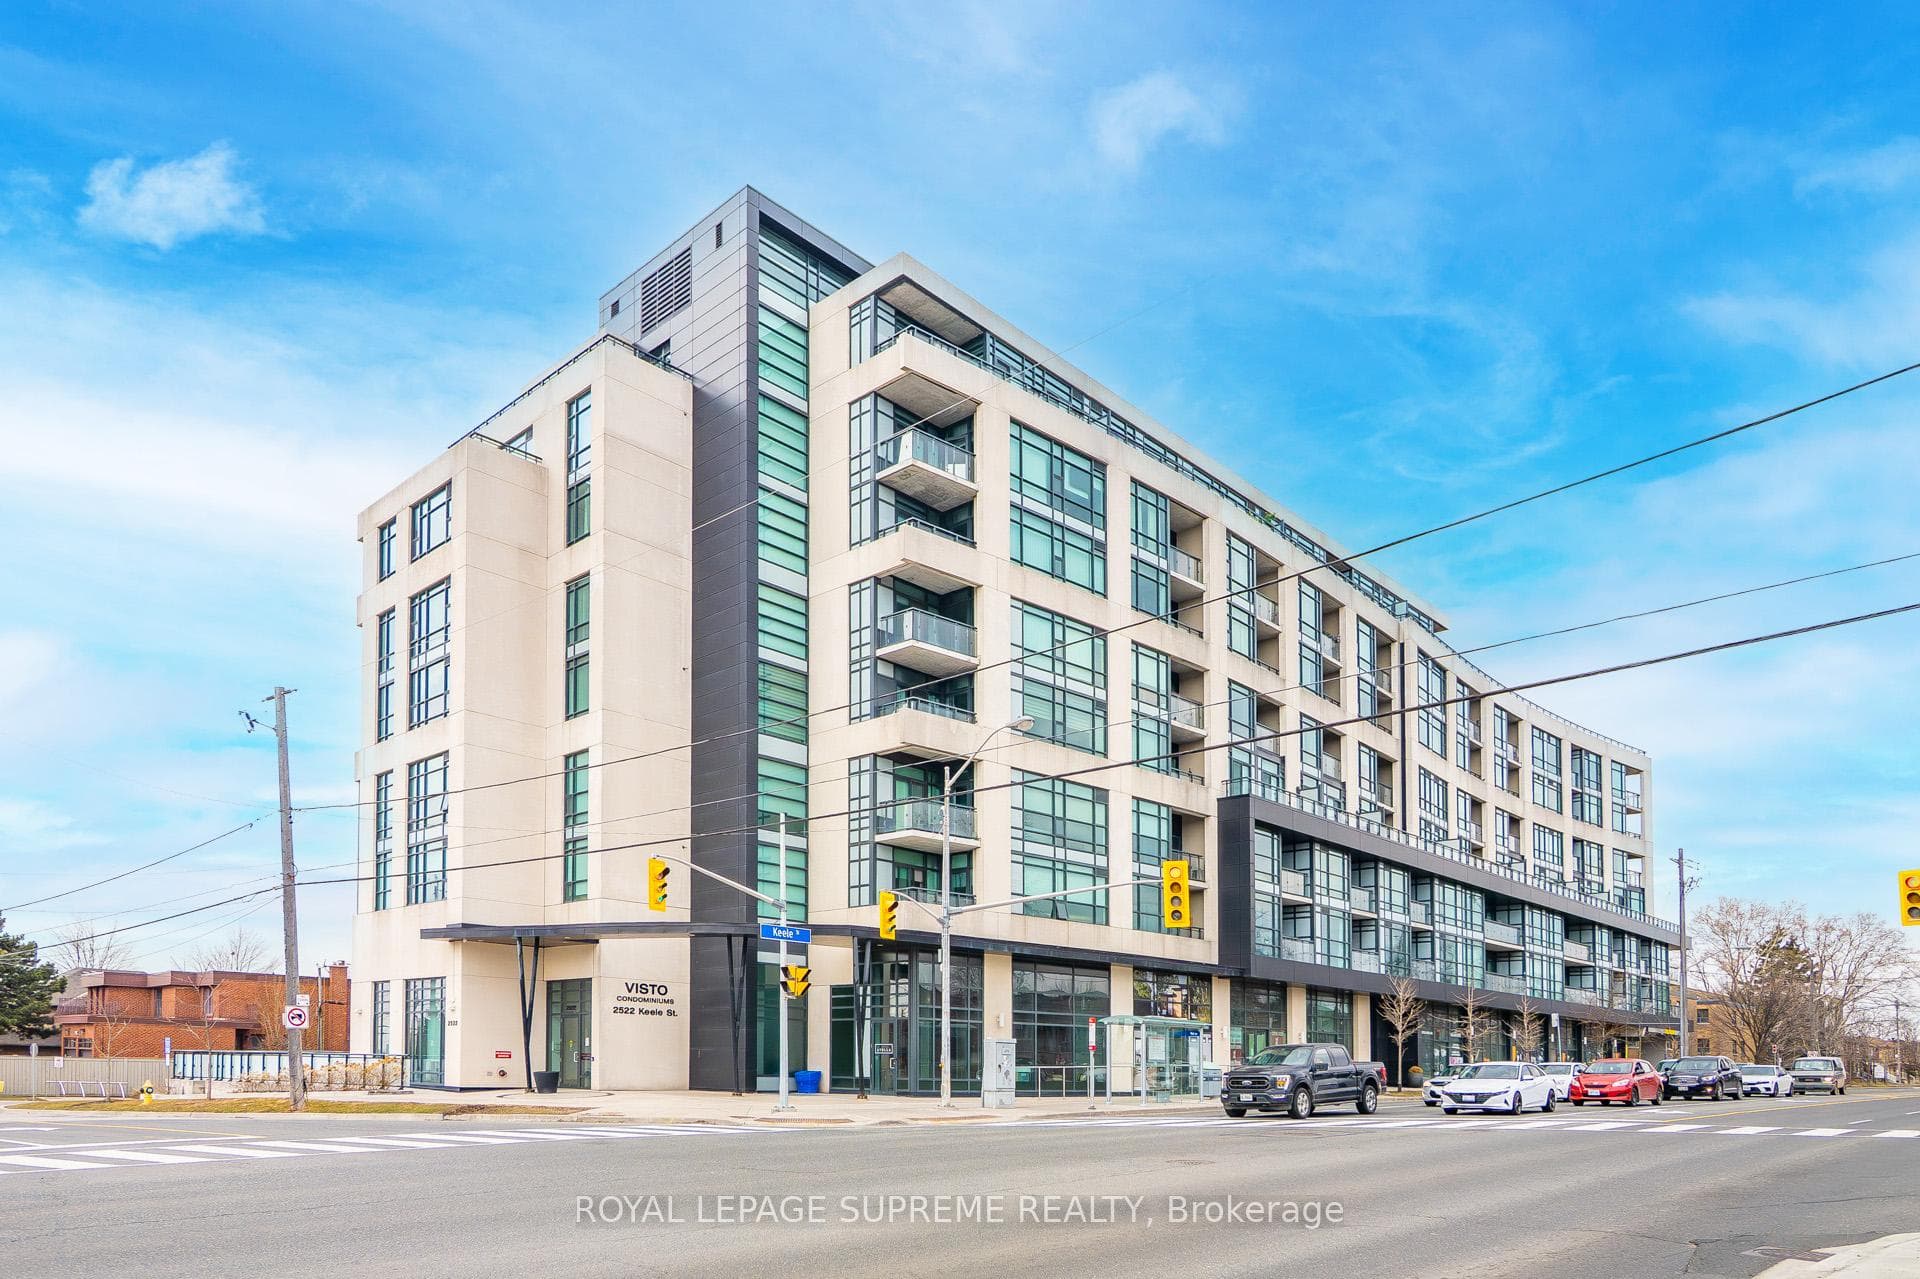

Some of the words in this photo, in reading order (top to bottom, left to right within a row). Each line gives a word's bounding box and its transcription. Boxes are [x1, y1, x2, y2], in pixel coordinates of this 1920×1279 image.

[772, 926, 794, 939] Keele
[625, 982, 668, 996] VISTO
[616, 995, 674, 1004] CONDOMINIUMS
[612, 1006, 636, 1015] 2522
[638, 1007, 663, 1016] Keele
[666, 1008, 678, 1017] St.
